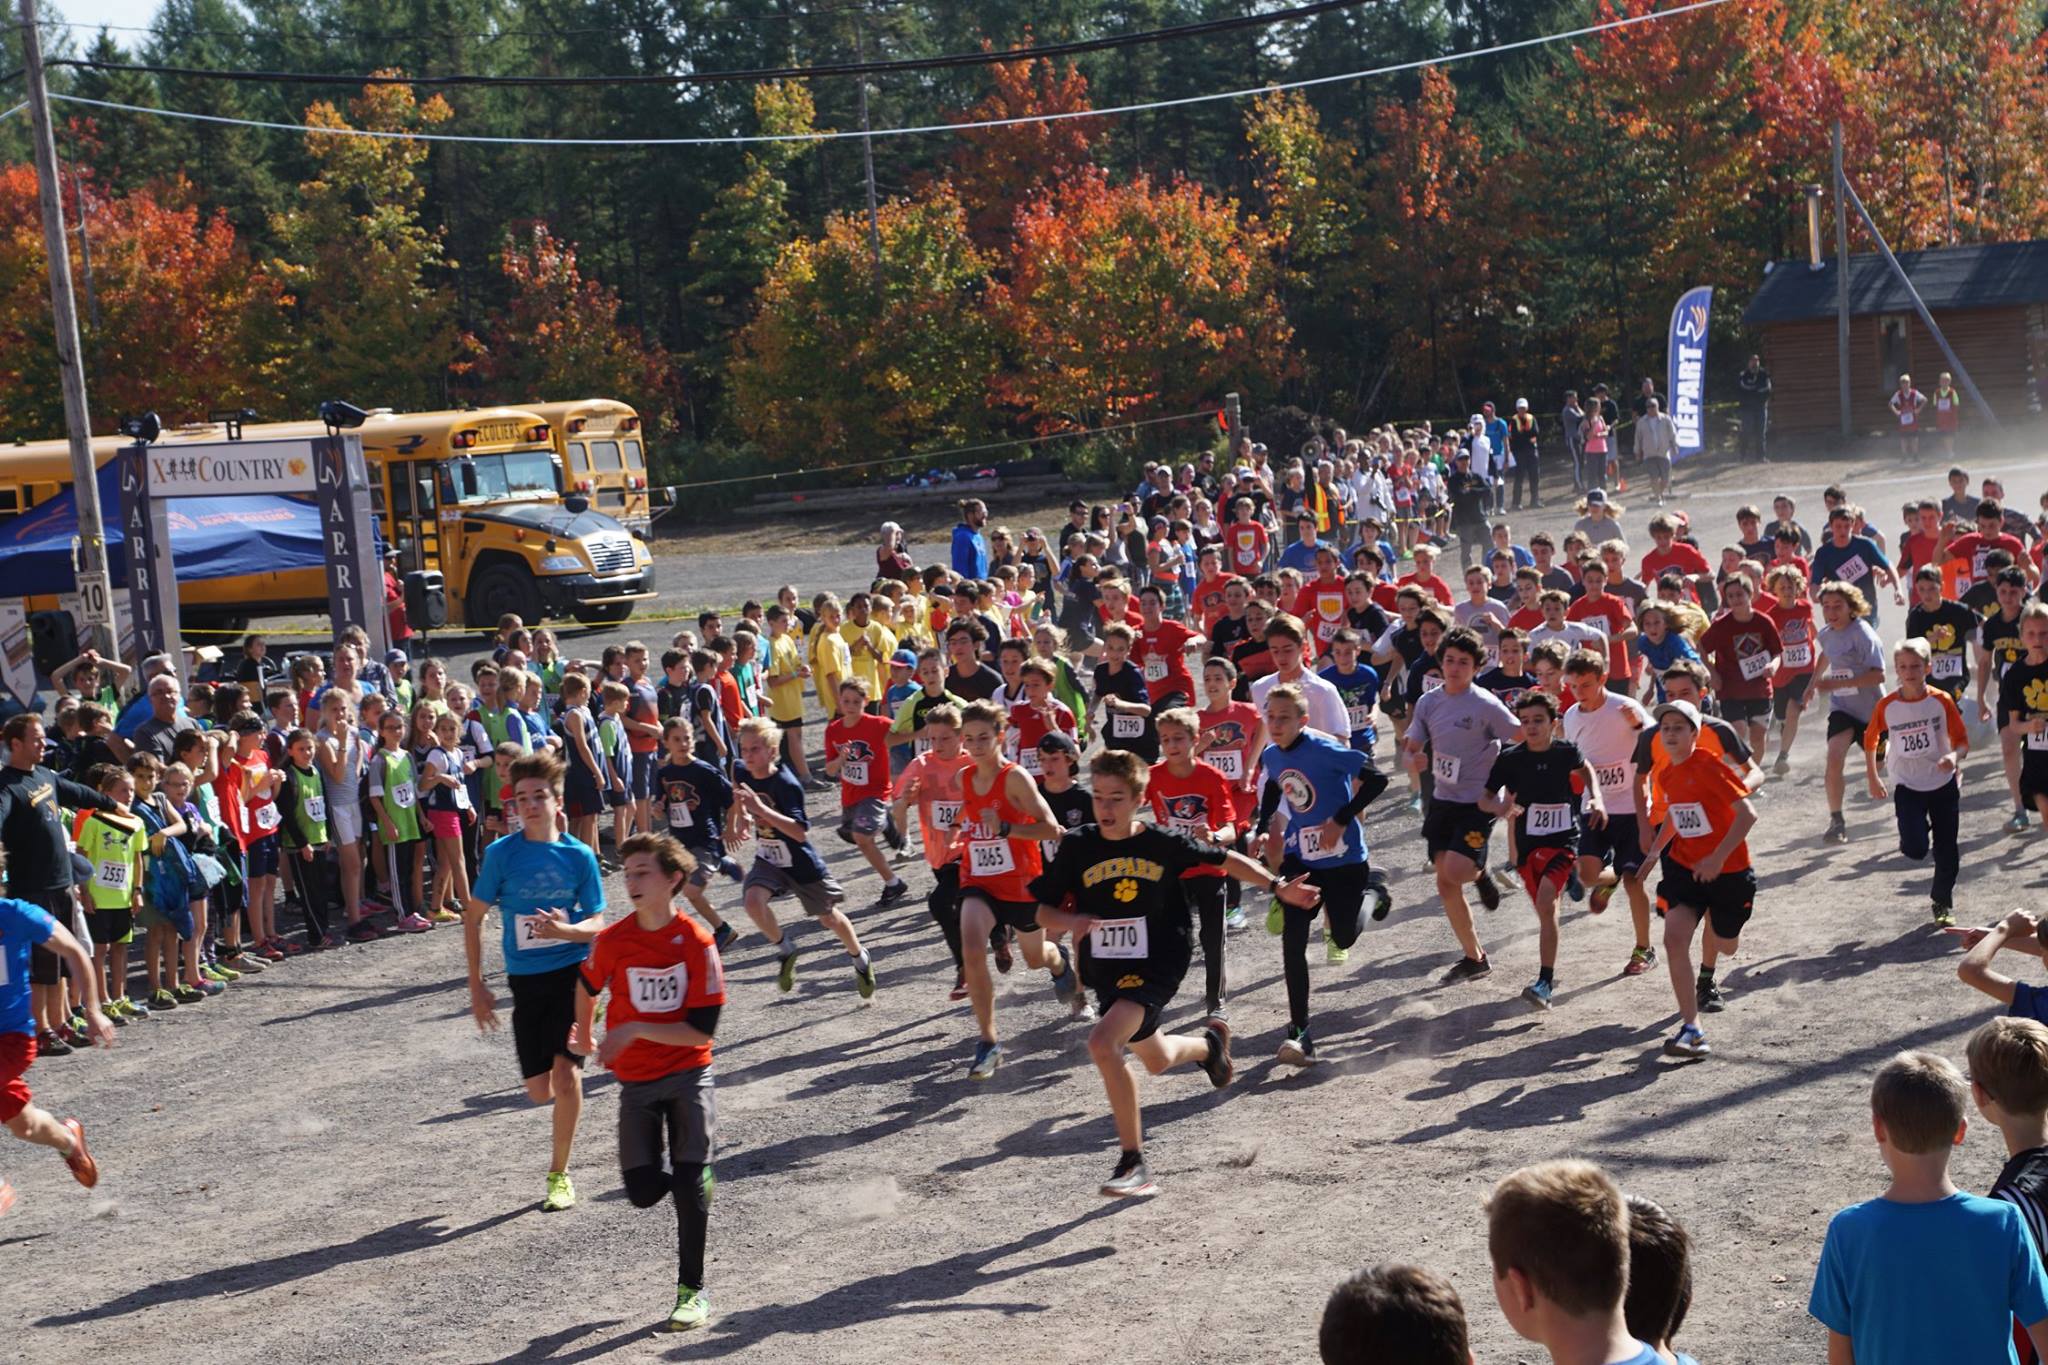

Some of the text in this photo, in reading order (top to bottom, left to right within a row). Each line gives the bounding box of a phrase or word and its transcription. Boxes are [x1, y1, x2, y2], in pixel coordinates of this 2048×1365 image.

[1674, 344, 1702, 447] DÉPART
[153, 457, 168, 483] X
[80, 584, 104, 614] 10
[1901, 731, 1931, 753] 2863
[1534, 810, 1564, 830] 2811
[1100, 926, 1137, 948] 2770
